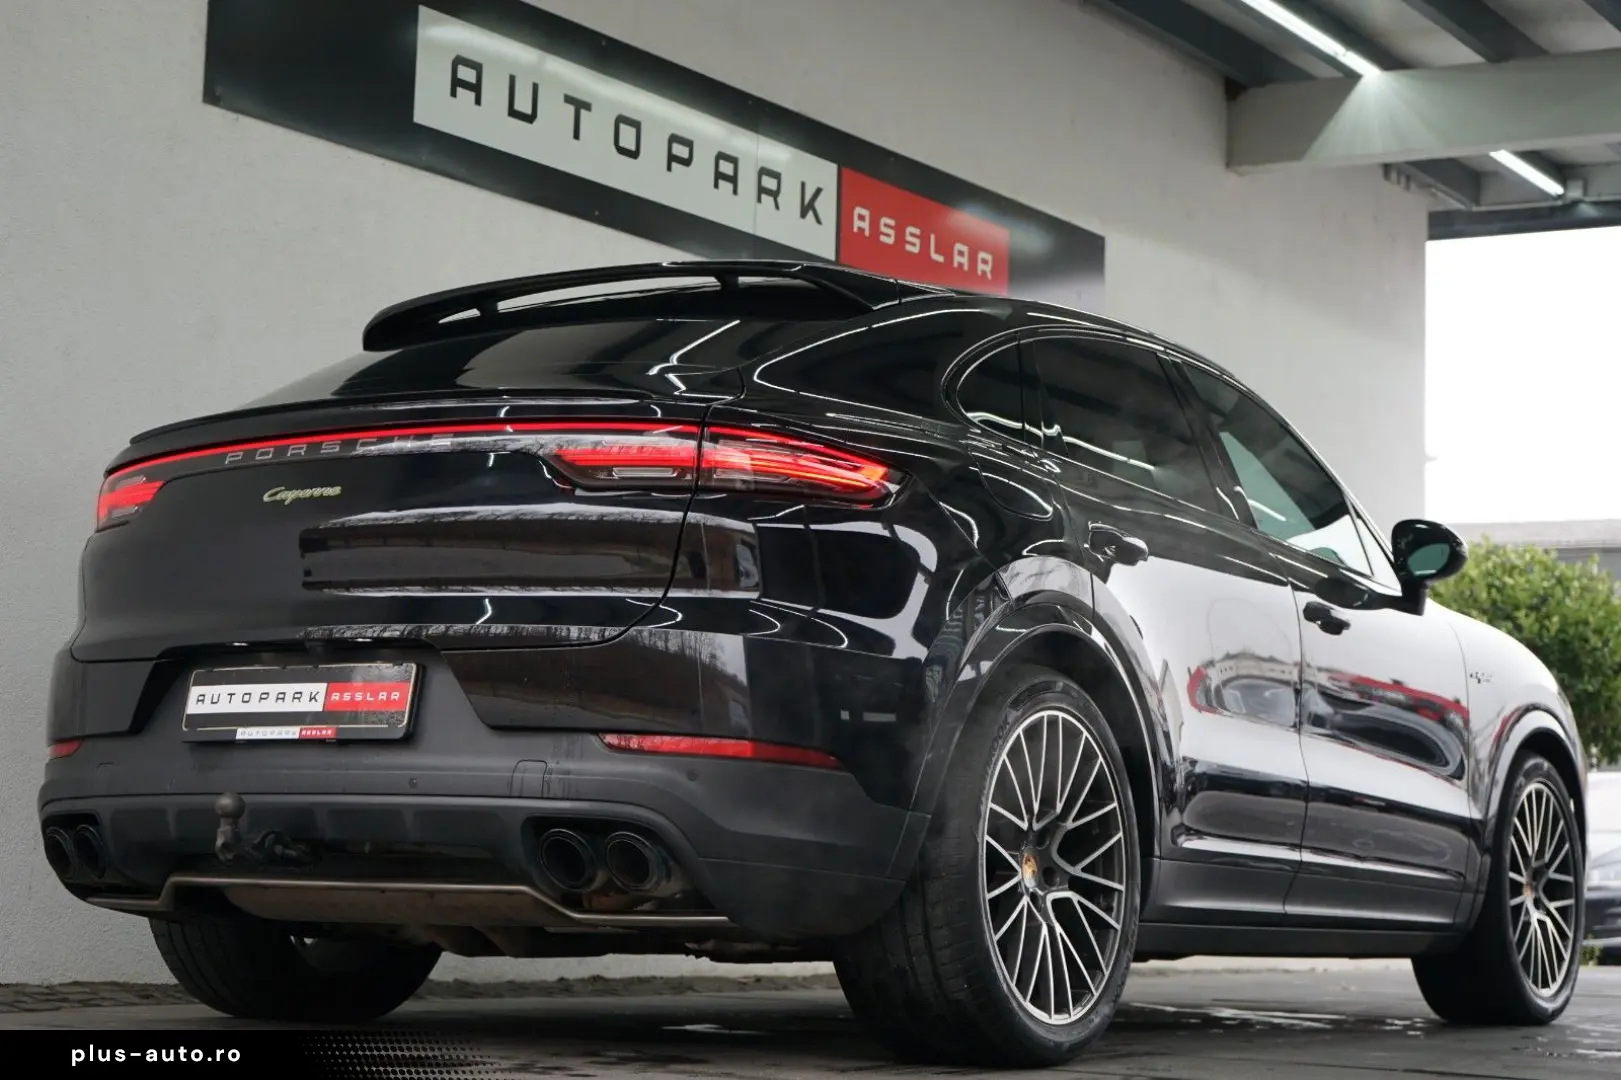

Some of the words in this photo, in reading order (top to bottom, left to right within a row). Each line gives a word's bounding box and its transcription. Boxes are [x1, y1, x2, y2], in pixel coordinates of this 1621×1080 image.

[449, 54, 823, 225] AUTOPARK
[853, 206, 993, 280] ASSLAR
[263, 486, 341, 505] Cayenne
[195, 691, 320, 706] AUTOPARK
[330, 690, 400, 702] ASSLAR
[240, 728, 298, 737] AUTOPARK
